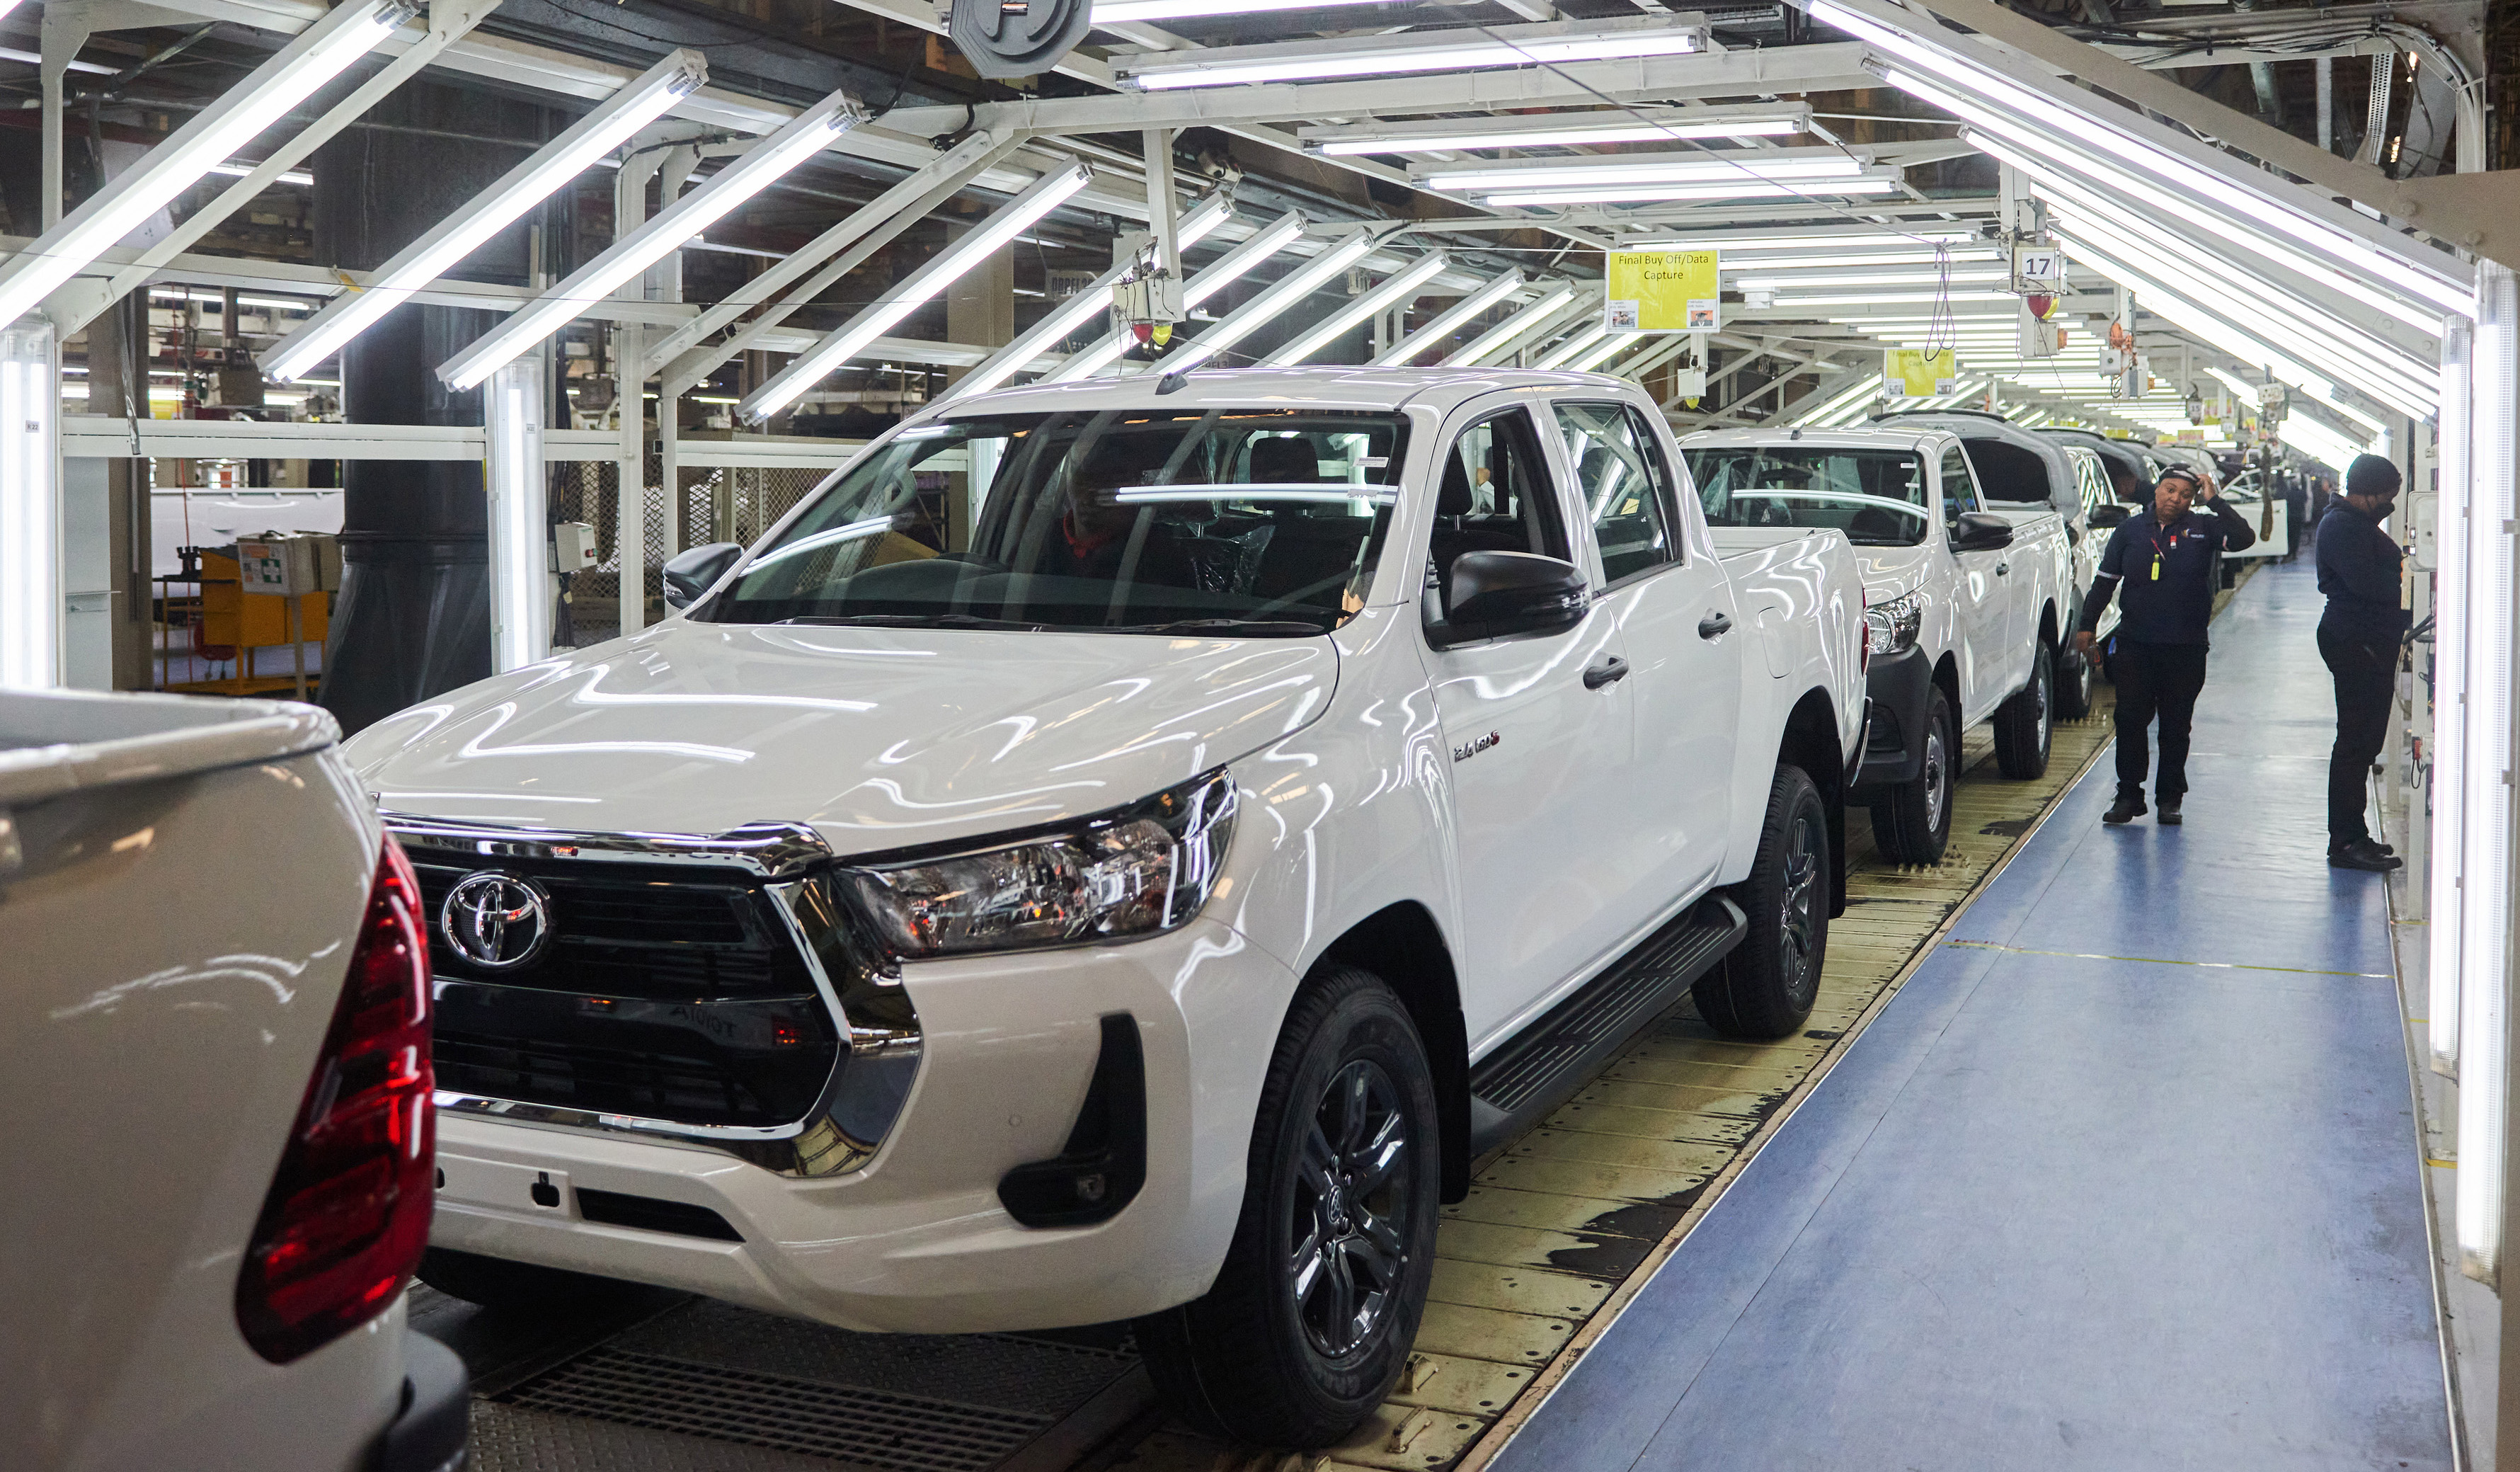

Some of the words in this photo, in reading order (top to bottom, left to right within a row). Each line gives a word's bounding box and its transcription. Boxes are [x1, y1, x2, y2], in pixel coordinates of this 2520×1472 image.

[1619, 256, 1642, 264] Final
[1645, 256, 1663, 266] Buy
[1666, 254, 1709, 265] Off/Data
[2026, 258, 2050, 275] 17
[1644, 270, 1683, 281] Capture
[1909, 350, 1920, 359] Buy
